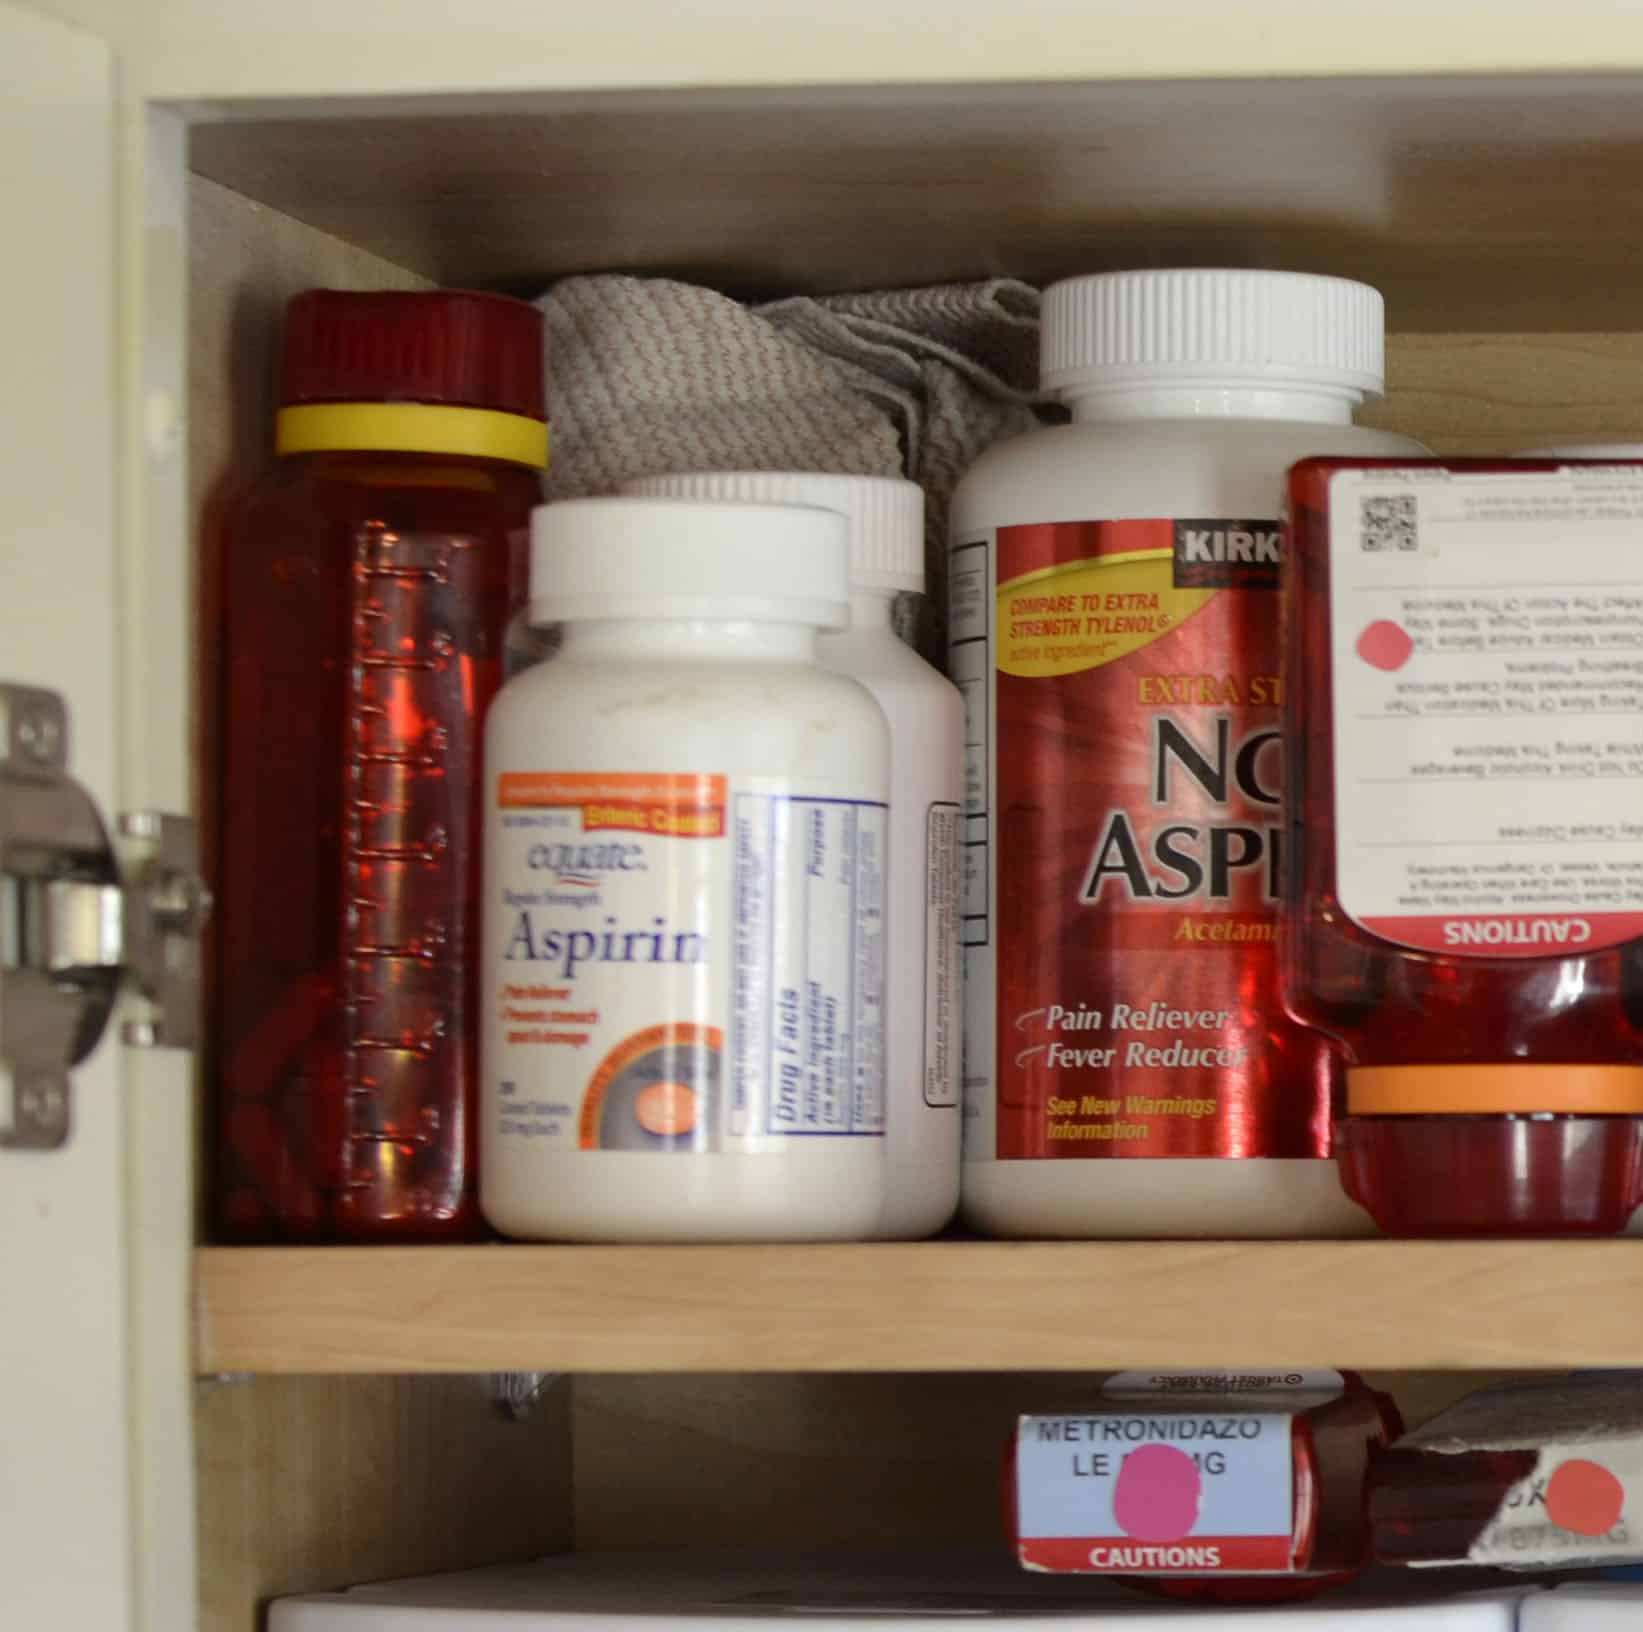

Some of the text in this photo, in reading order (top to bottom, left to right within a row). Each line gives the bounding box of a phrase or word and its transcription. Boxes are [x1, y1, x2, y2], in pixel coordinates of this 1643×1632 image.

[1186, 531, 1281, 563] KIRK
[1010, 594, 1161, 617] COMPARE TO EXTRA
[1010, 618, 1080, 640] STRENGTH
[1140, 675, 1241, 706] EXTRA
[504, 911, 709, 979] Aspirin
[1444, 921, 1592, 945] CAUTIONS
[1047, 1001, 1229, 1031] Pain Reliever
[776, 988, 800, 1122] Drug Facts
[1047, 1039, 1248, 1068] Fever Reducer
[1047, 1096, 1217, 1119] See New Warnings
[1047, 1121, 1149, 1141] Information
[1035, 1418, 1263, 1444] METRONIDAZO
[1072, 1454, 1109, 1477] LE
[1089, 1546, 1221, 1569] CAUTIONS
